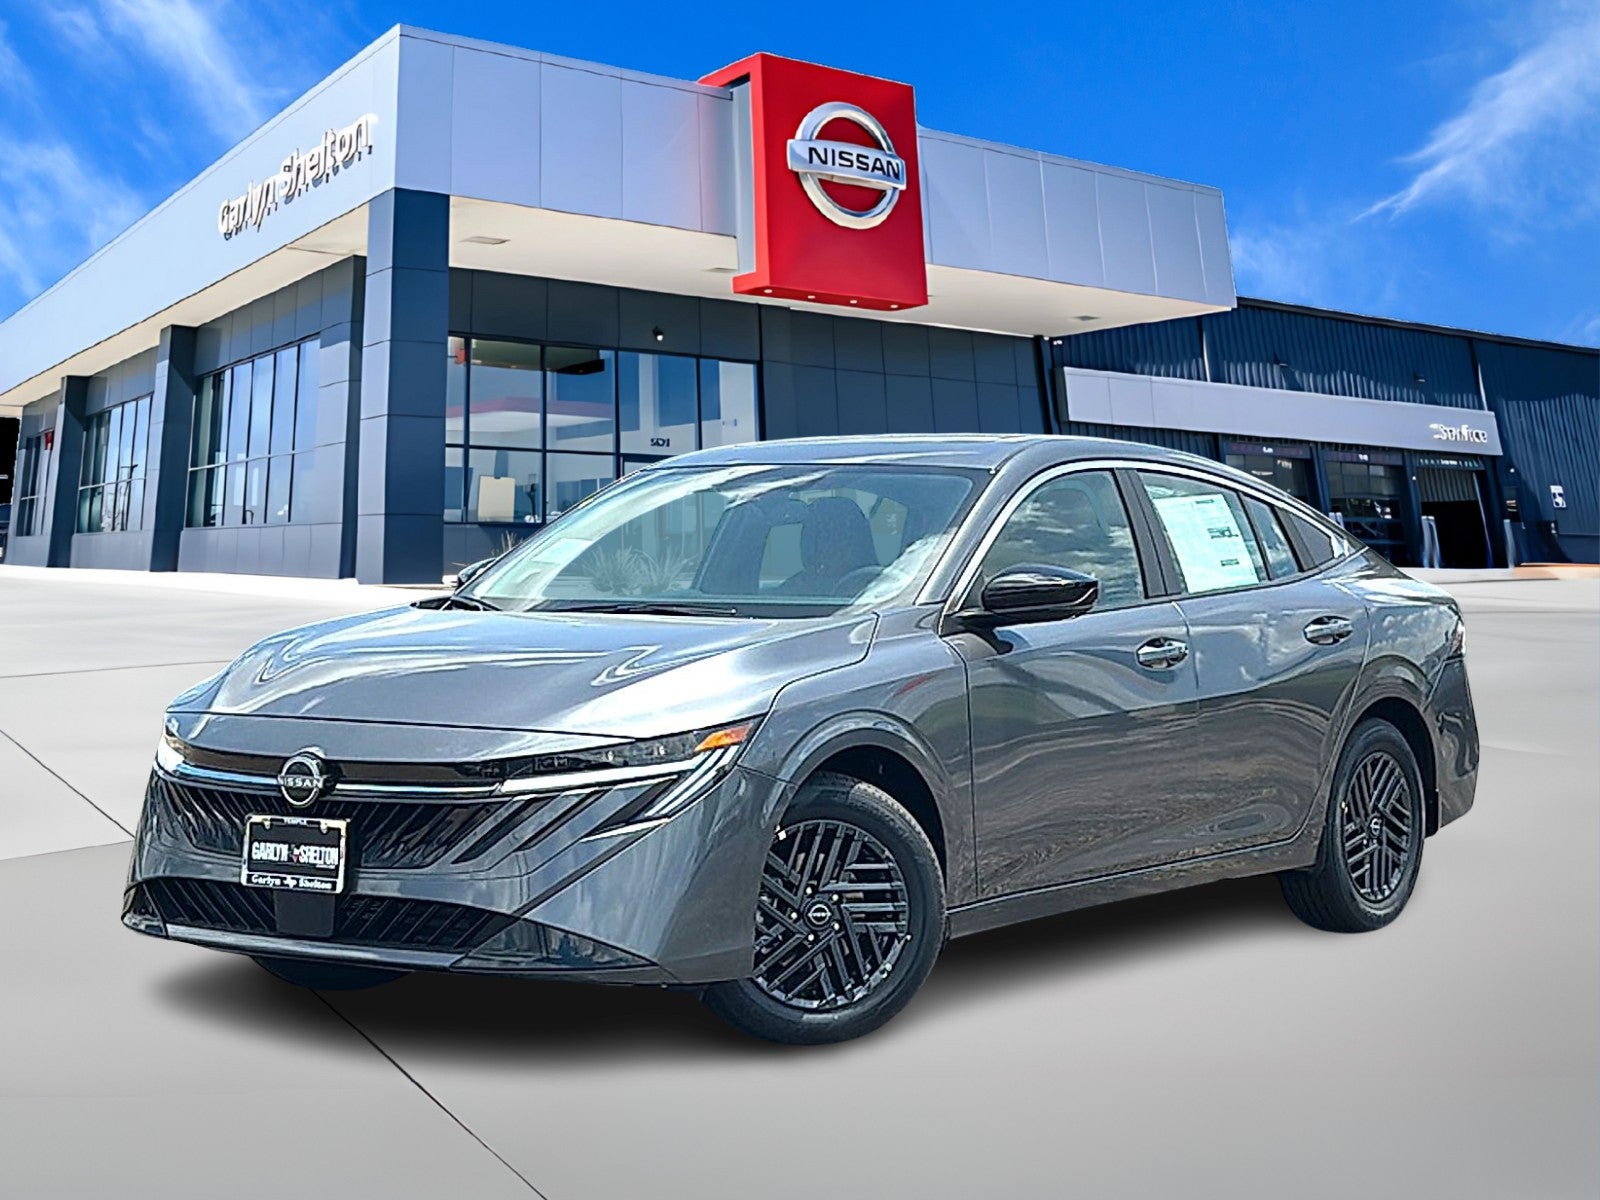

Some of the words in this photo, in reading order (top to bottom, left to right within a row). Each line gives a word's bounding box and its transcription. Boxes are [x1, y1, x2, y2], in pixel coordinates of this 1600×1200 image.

[279, 115, 375, 204] Shelton
[808, 146, 901, 181] NISSAN
[1429, 422, 1488, 443] Service
[278, 774, 323, 789] NISSAN
[251, 841, 289, 861] GARLYN
[299, 845, 339, 865] SHELTON
